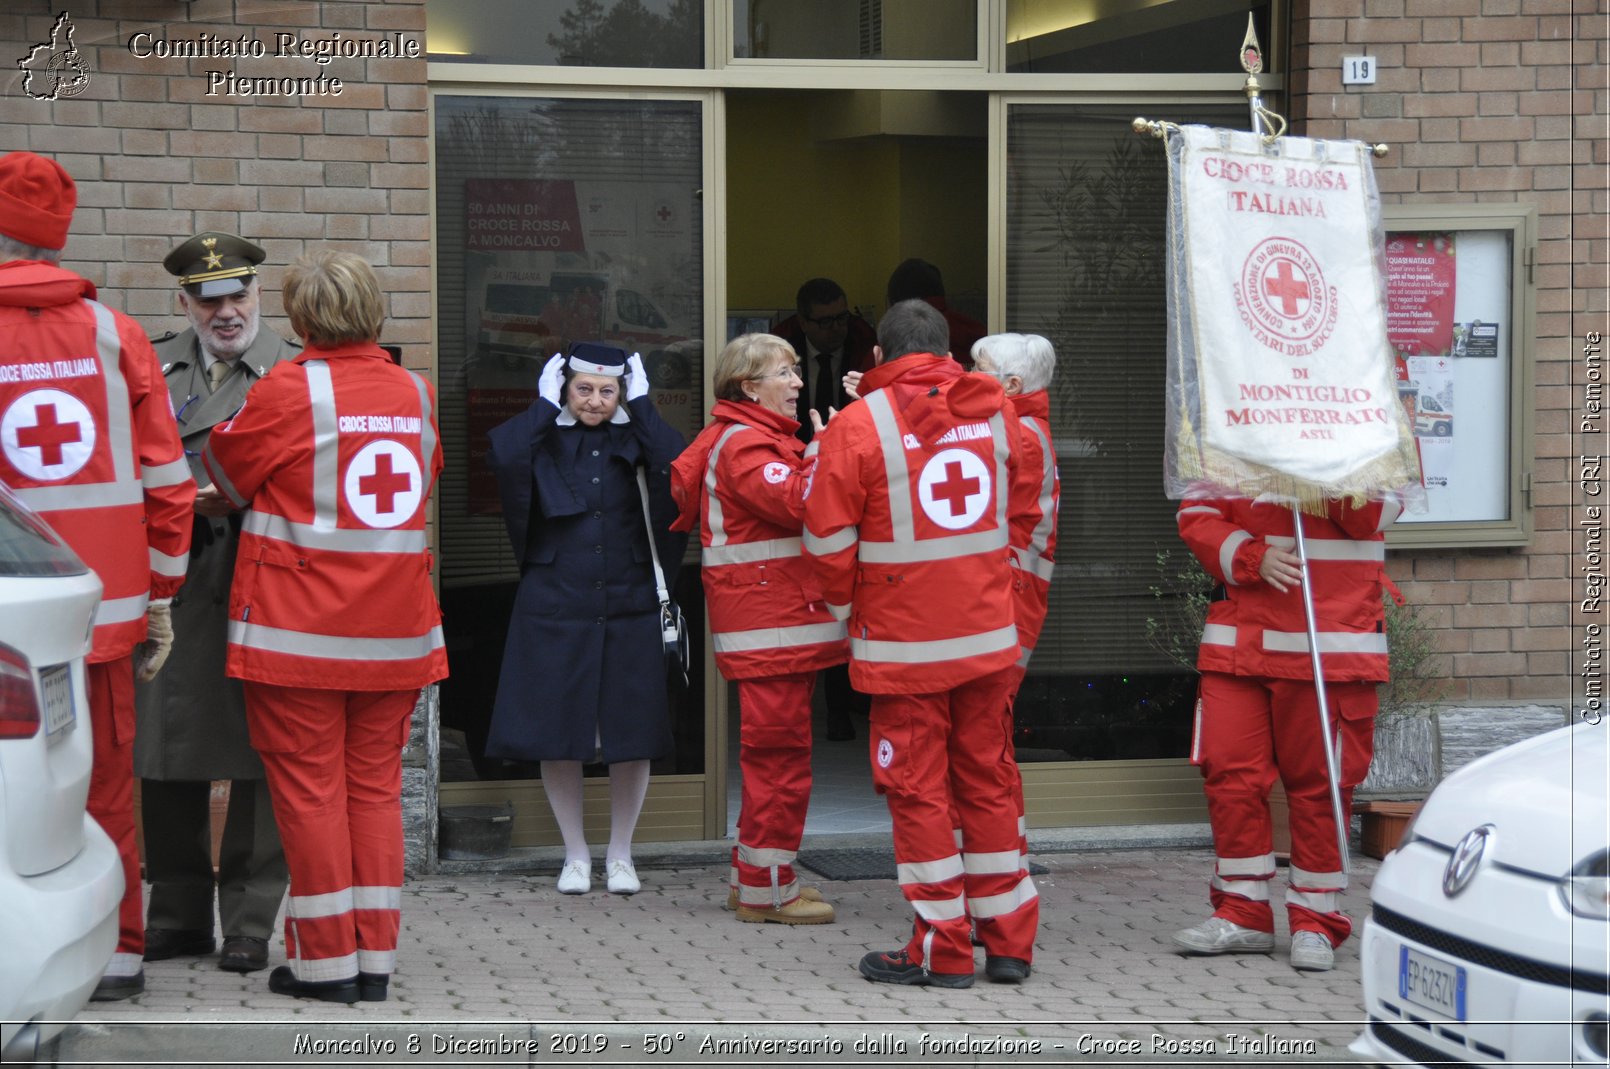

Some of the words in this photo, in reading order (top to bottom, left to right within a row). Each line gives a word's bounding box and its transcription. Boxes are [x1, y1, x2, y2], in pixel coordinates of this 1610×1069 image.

[1352, 60, 1369, 79] 19
[1285, 166, 1348, 190] ROSSA
[468, 203, 483, 215] 50
[486, 203, 521, 215] ANNI
[524, 204, 538, 216] DI
[468, 219, 518, 231] CROCE
[522, 220, 571, 232] ROSSA
[468, 234, 478, 246] A
[480, 235, 561, 247] MONCALVO
[1256, 251, 1268, 264] DI
[1265, 243, 1302, 260] GINEVRA
[1248, 262, 1283, 329] CONVENZIONE
[1309, 272, 1322, 314] AGOSTO
[1286, 343, 1313, 357] DEL
[1311, 286, 1338, 351] SOCCORSO
[0, 364, 20, 383] OCE
[20, 361, 54, 381] ROSSA
[53, 357, 99, 378] ITALIANA
[1291, 367, 1309, 380] DI
[657, 393, 687, 406] 2019
[1239, 383, 1371, 404] MONTIGLIO
[339, 415, 368, 433] CROCE
[368, 415, 393, 433] ROSSA
[1225, 407, 1388, 427] MONFERRATO
[957, 421, 992, 441] ITALIANA
[1299, 428, 1333, 440] ASTI
